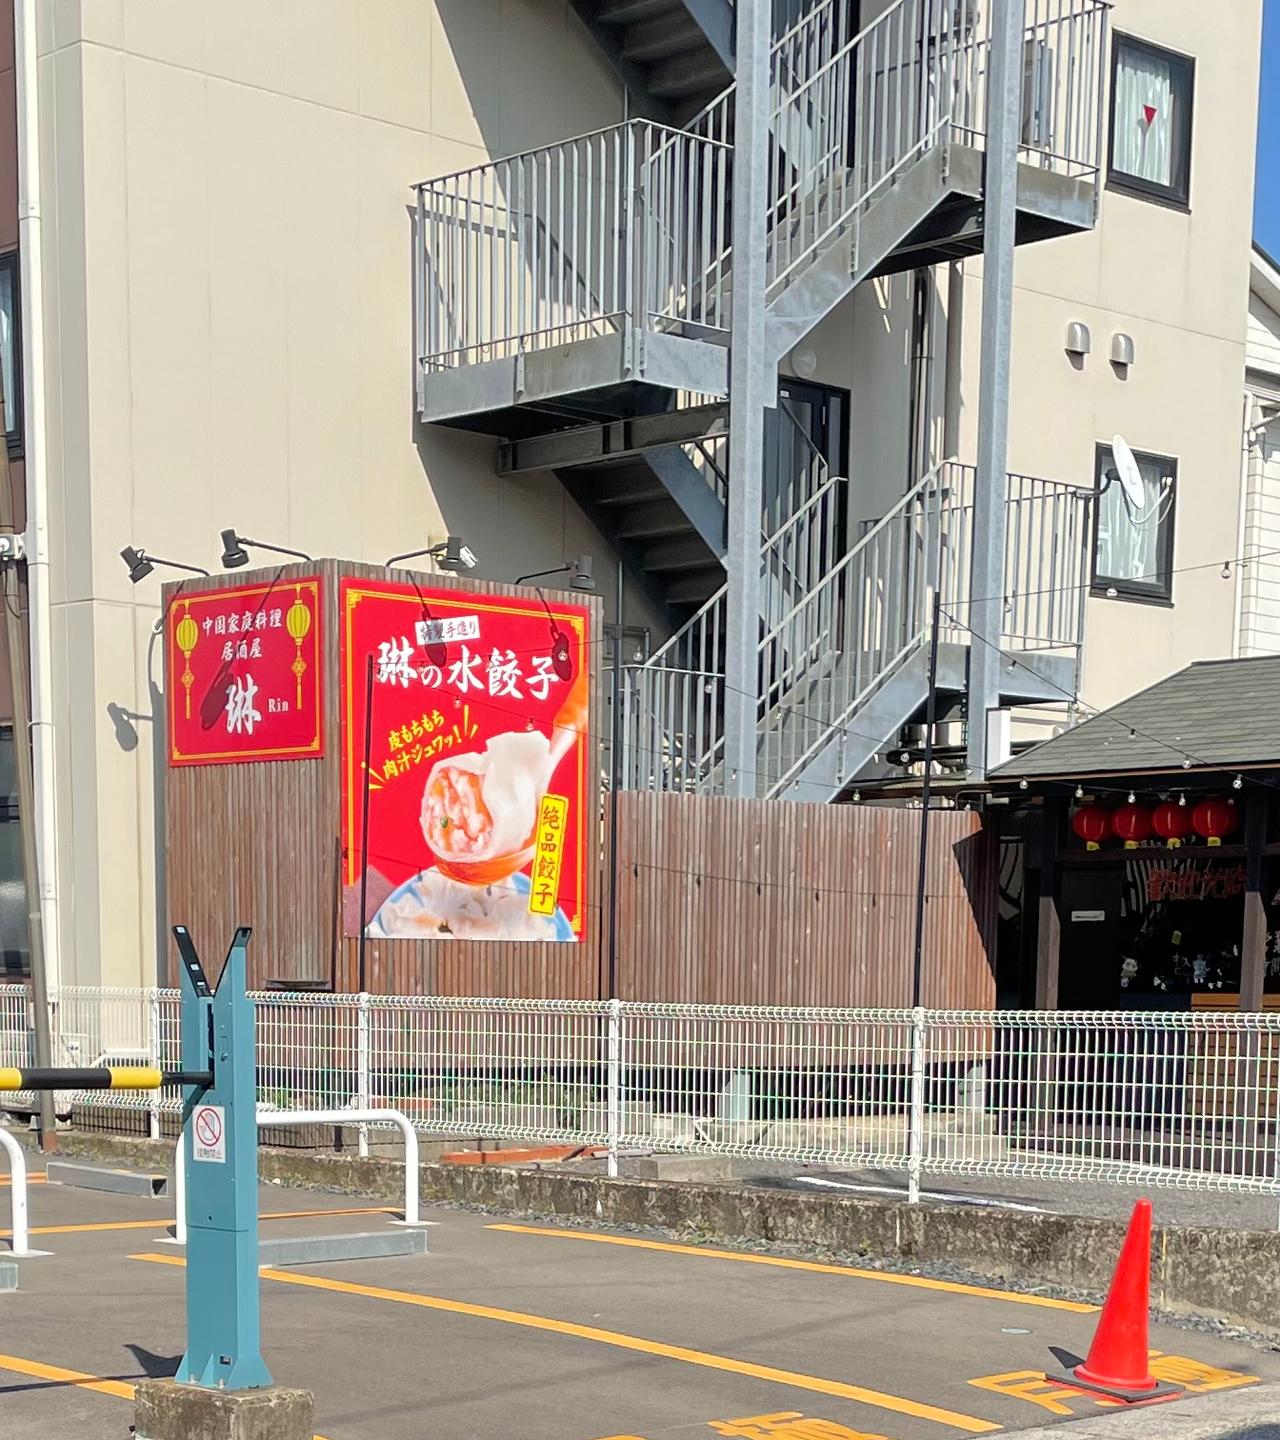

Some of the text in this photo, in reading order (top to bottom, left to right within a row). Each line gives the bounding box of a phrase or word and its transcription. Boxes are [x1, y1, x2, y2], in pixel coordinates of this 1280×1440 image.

[202, 608, 283, 637] 中国家庭料理
[221, 637, 263, 661] 居酒屋
[377, 635, 561, 700] 琳の水餃子
[225, 673, 289, 735] 琳 Rin
[388, 709, 445, 752] 皮もちもち
